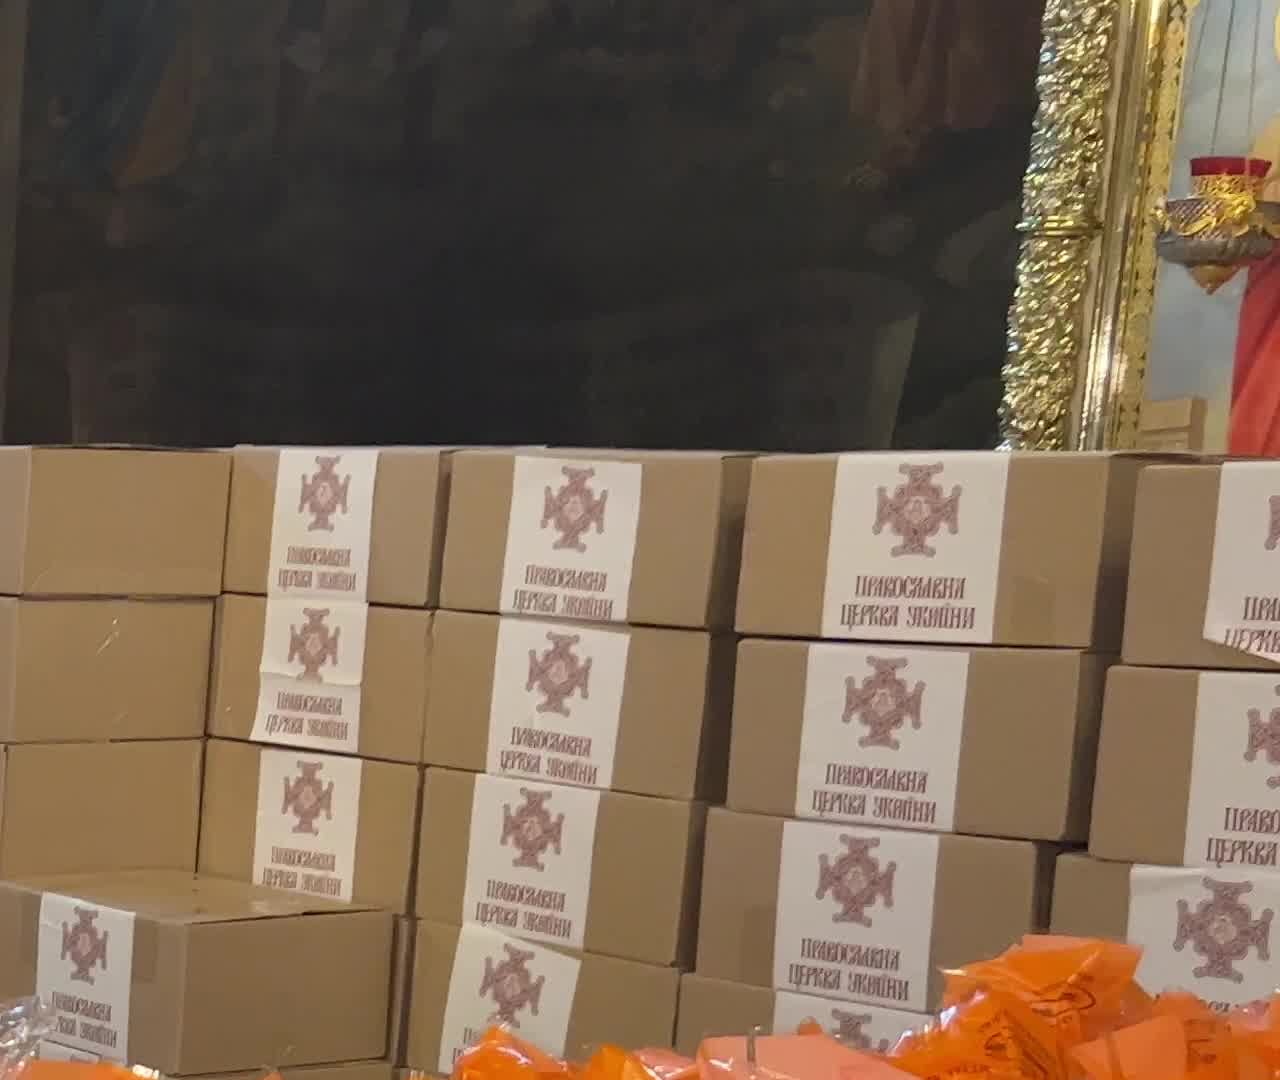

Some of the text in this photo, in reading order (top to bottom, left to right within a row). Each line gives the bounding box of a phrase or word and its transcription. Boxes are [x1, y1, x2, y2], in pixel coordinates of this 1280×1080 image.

[855, 575, 966, 600] ПРАВОСЛАВНА
[840, 603, 899, 631] ЦЕРКВА
[1206, 837, 1278, 869] ЦЕРКВА
